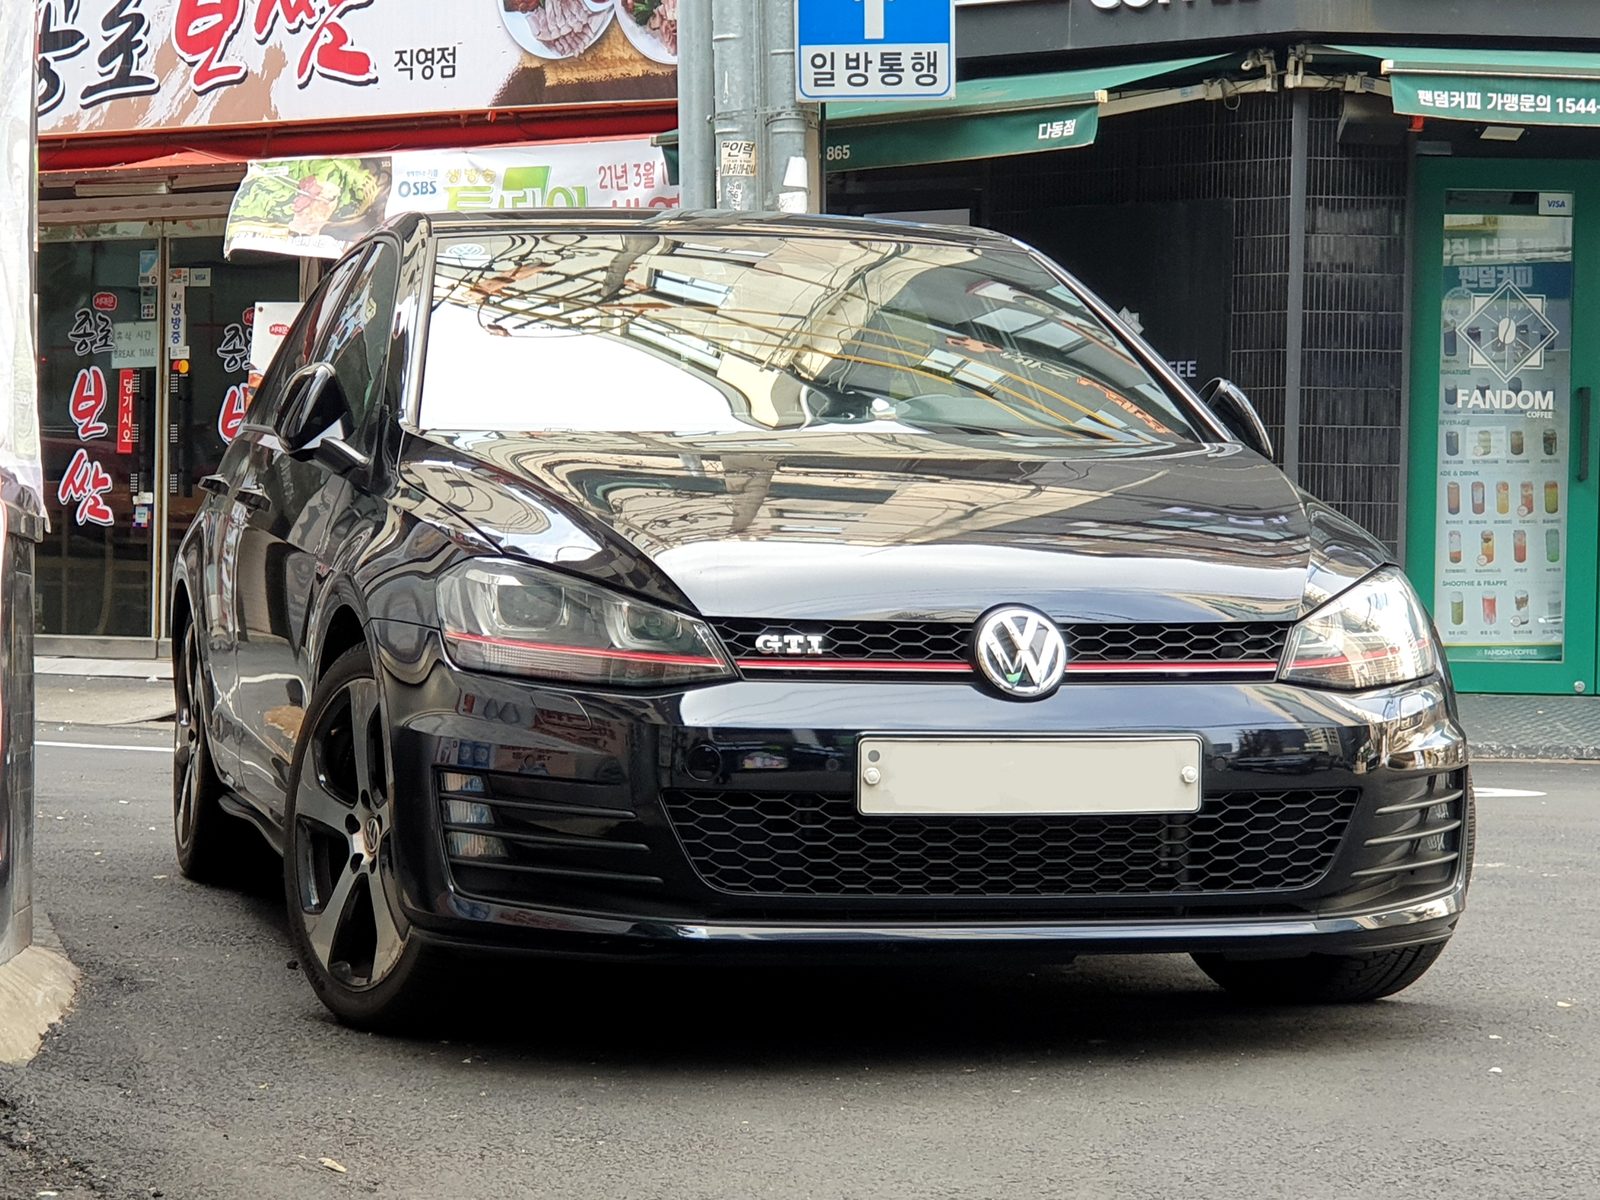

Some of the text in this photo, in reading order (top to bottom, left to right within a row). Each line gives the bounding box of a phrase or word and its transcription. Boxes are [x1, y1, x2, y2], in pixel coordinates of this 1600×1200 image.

[394, 46, 457, 81] 직영점
[810, 51, 939, 88] 일방통행
[1417, 90, 1482, 110] 팬덤커피
[1486, 92, 1551, 113] 가맹문의
[1038, 118, 1077, 140] 다동점
[826, 145, 851, 161] 865
[446, 166, 497, 185] 생방송
[598, 163, 629, 191] 21년
[633, 160, 655, 189] 3월
[412, 180, 438, 196] SBS
[1547, 199, 1566, 208] VISA
[68, 308, 116, 357] 종로
[170, 302, 182, 345] 냉방중
[138, 347, 156, 357] TIME
[1456, 388, 1554, 410] FANDOM
[121, 378, 134, 443] 당기시오
[1526, 410, 1553, 419] COFFEE
[1483, 579, 1507, 587] FRAPPE
[754, 633, 823, 655] GTI
[1483, 648, 1538, 656] FANDOM COFFEE
